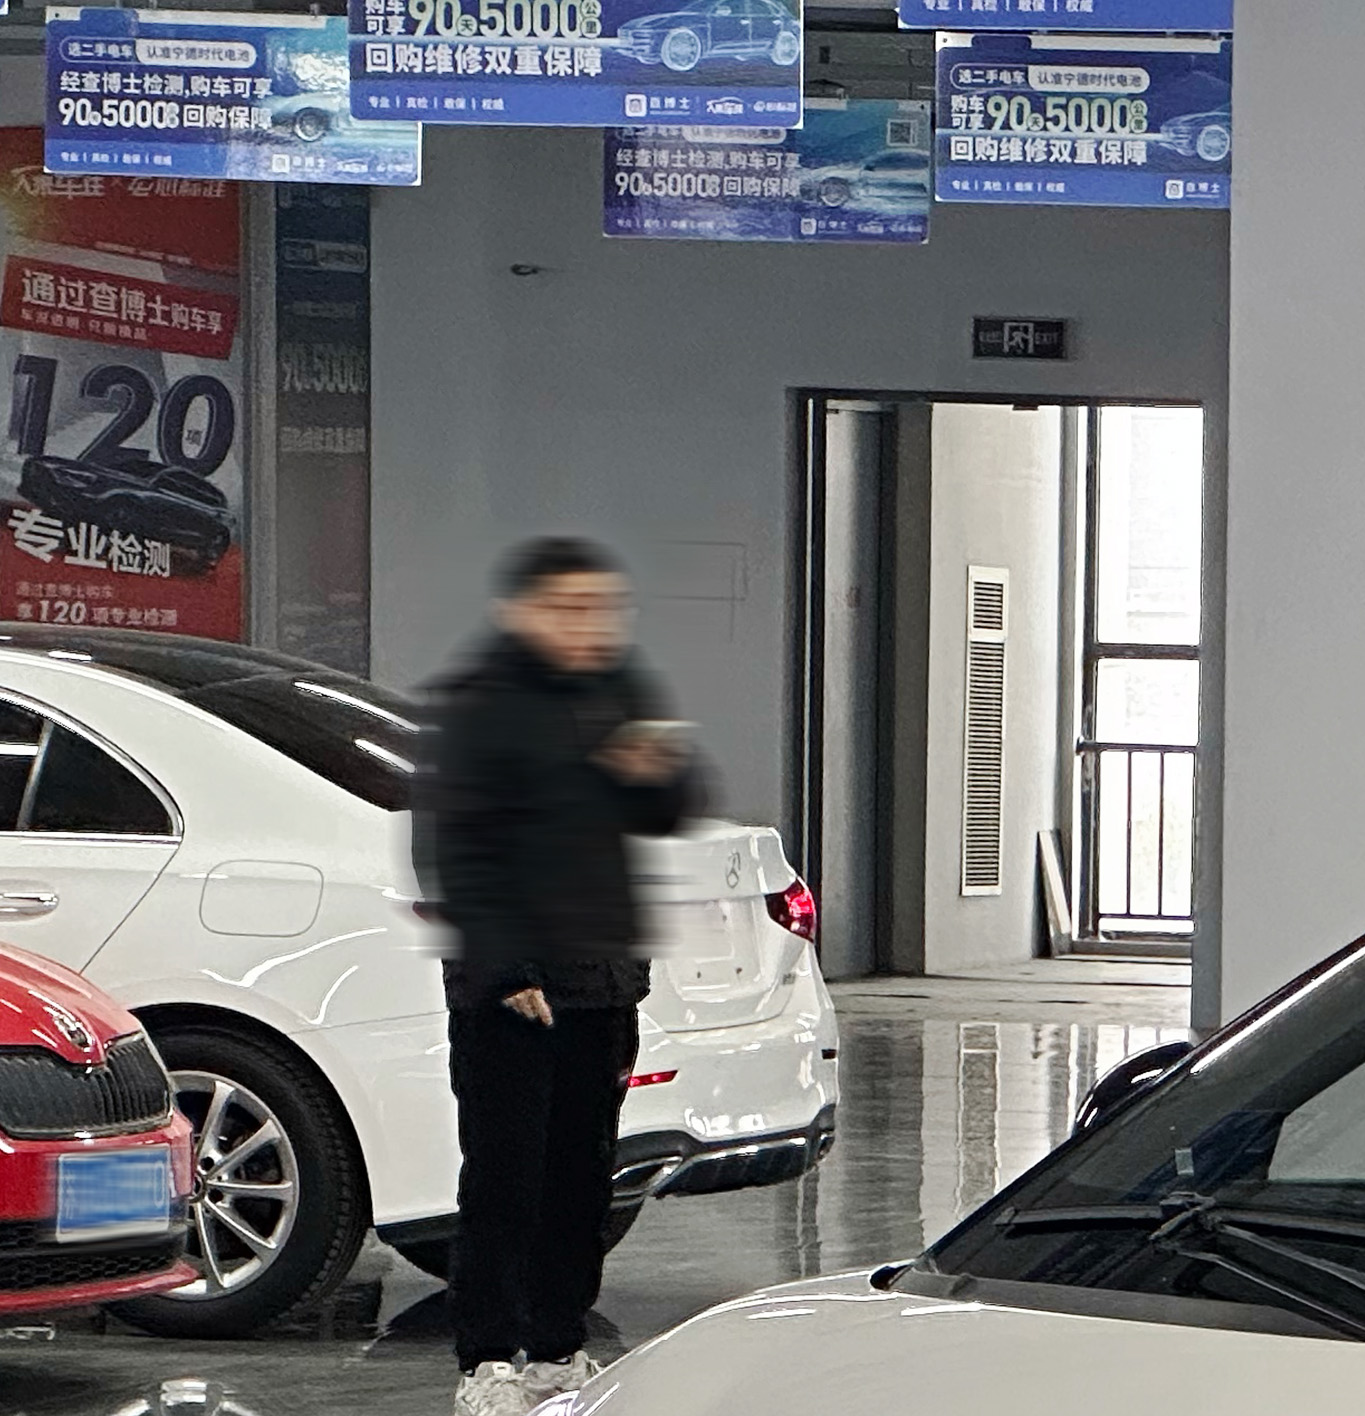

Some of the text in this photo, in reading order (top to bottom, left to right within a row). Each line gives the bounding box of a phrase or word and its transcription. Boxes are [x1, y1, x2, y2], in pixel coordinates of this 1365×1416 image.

[365, 16, 405, 35] 可享
[364, 42, 602, 77] 回购维修双重保障
[60, 70, 273, 98] 经查博士检测,购车可享
[1038, 72, 1142, 87] 认准宁德时代电池
[950, 136, 1147, 165] 回购维修双重保障
[21, 270, 223, 335] 通过查博士购车享
[12, 353, 235, 477] 120
[7, 508, 171, 578] 专业检测
